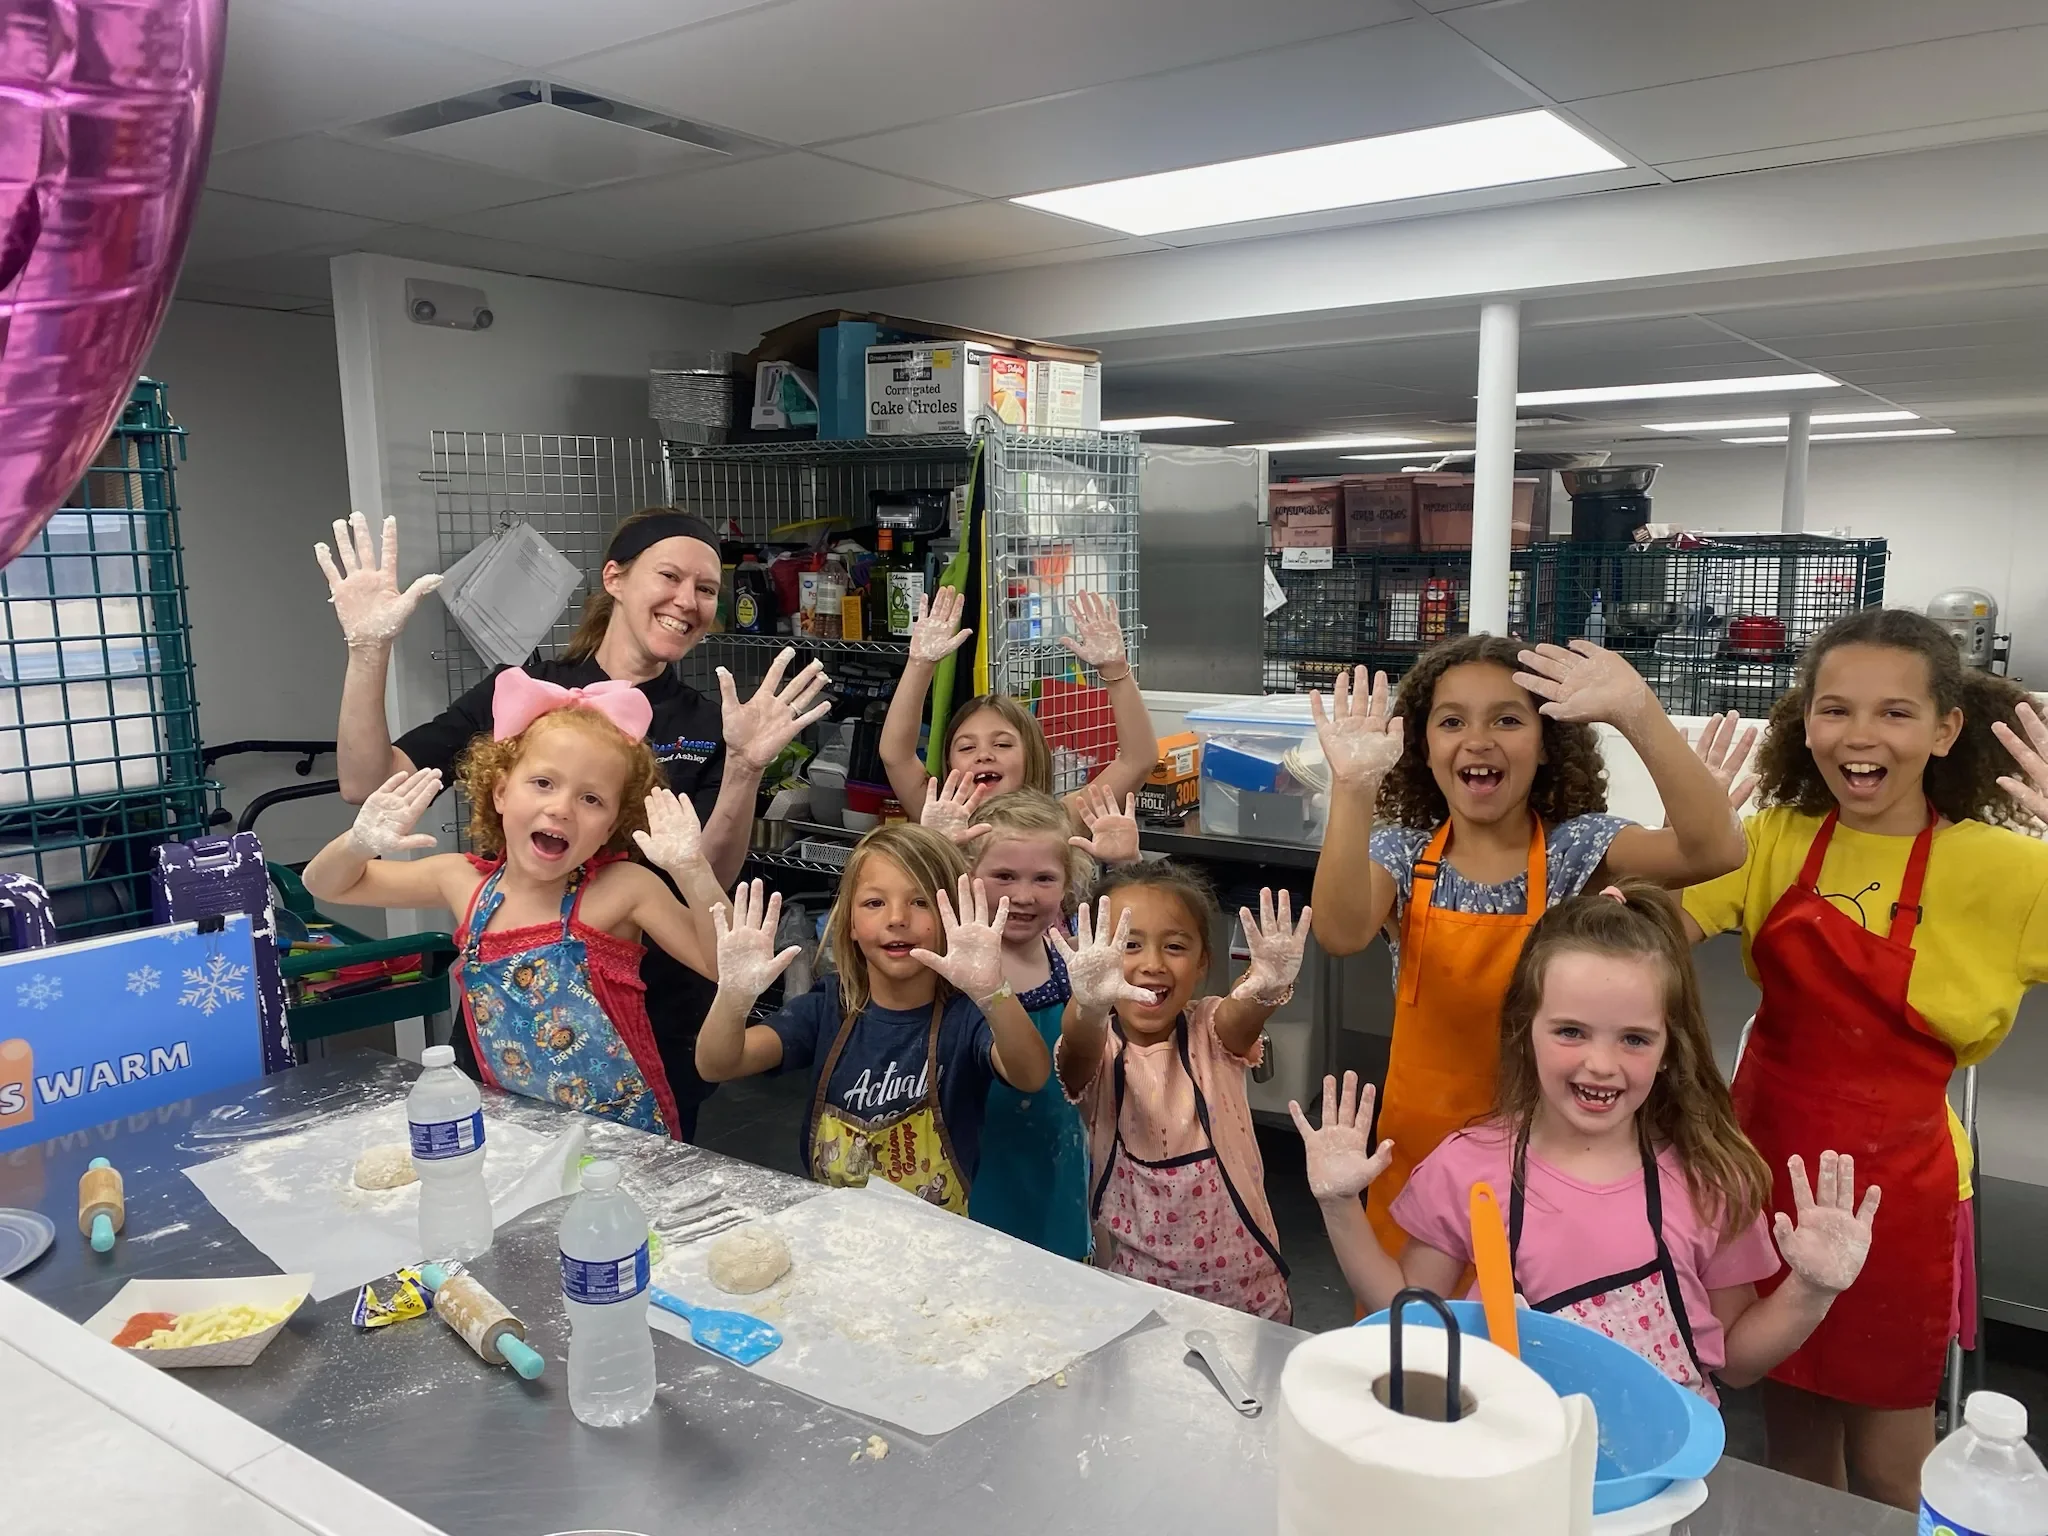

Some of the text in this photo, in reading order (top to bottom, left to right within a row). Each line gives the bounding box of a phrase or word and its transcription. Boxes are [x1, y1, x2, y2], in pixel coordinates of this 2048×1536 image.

[885, 384, 941, 397] Corrugated
[871, 400, 958, 416] Cake Circles
[1274, 504, 1331, 516] consumables
[682, 740, 717, 749] BASICS
[655, 753, 707, 764] Chef Ashley
[1145, 792, 1165, 800] SERVICE
[1141, 797, 1164, 811] ROLL
[500, 952, 527, 991] MIRABEL
[492, 1039, 528, 1054] MIRABEL
[549, 1031, 591, 1066] MIRABEL
[35, 1040, 193, 1105] WARM
[902, 1122, 918, 1175] George
